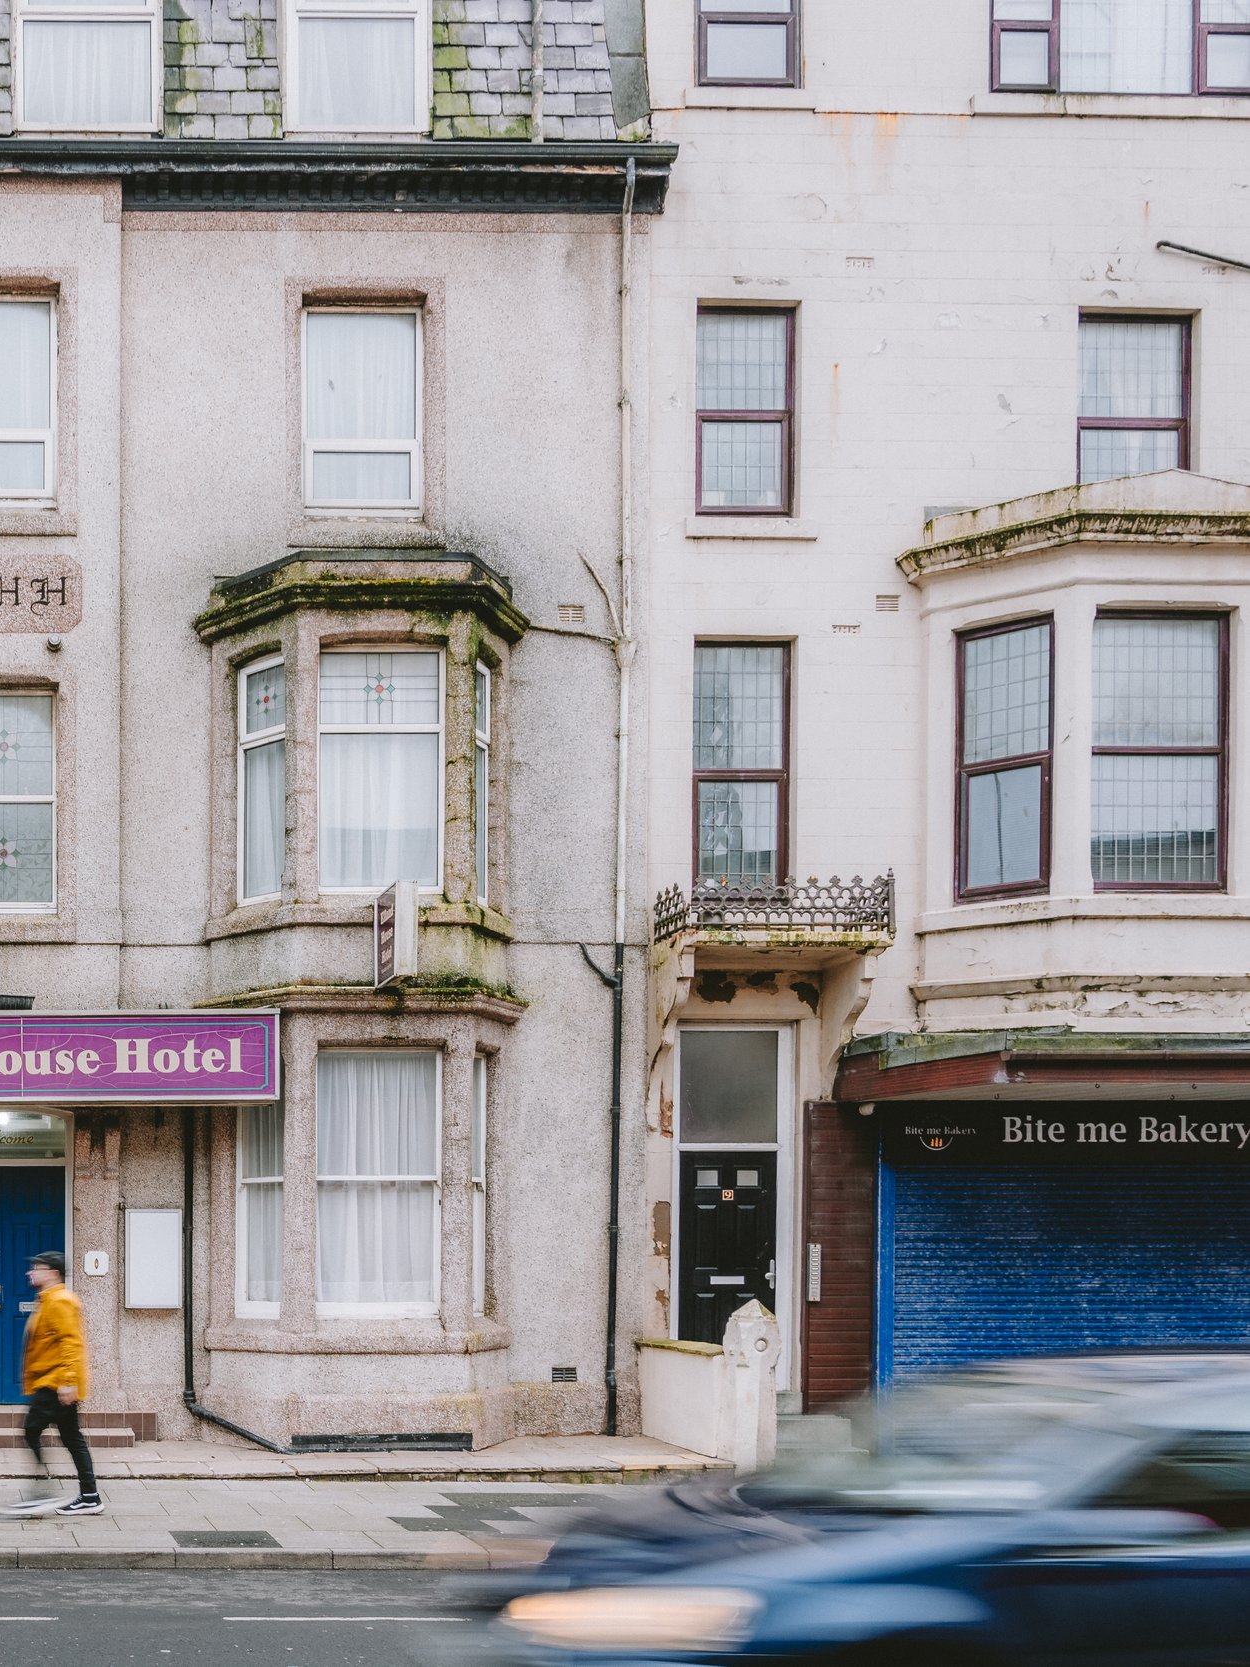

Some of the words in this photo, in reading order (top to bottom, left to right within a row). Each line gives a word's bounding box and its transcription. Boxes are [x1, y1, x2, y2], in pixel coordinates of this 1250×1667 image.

[114, 1037, 243, 1074] Hotel
[905, 1126, 924, 1135] Bite
[926, 1127, 942, 1135] me
[1002, 1115, 1066, 1143] Bite
[1076, 1122, 1127, 1143] me
[1138, 1115, 1250, 1149] Bakery
